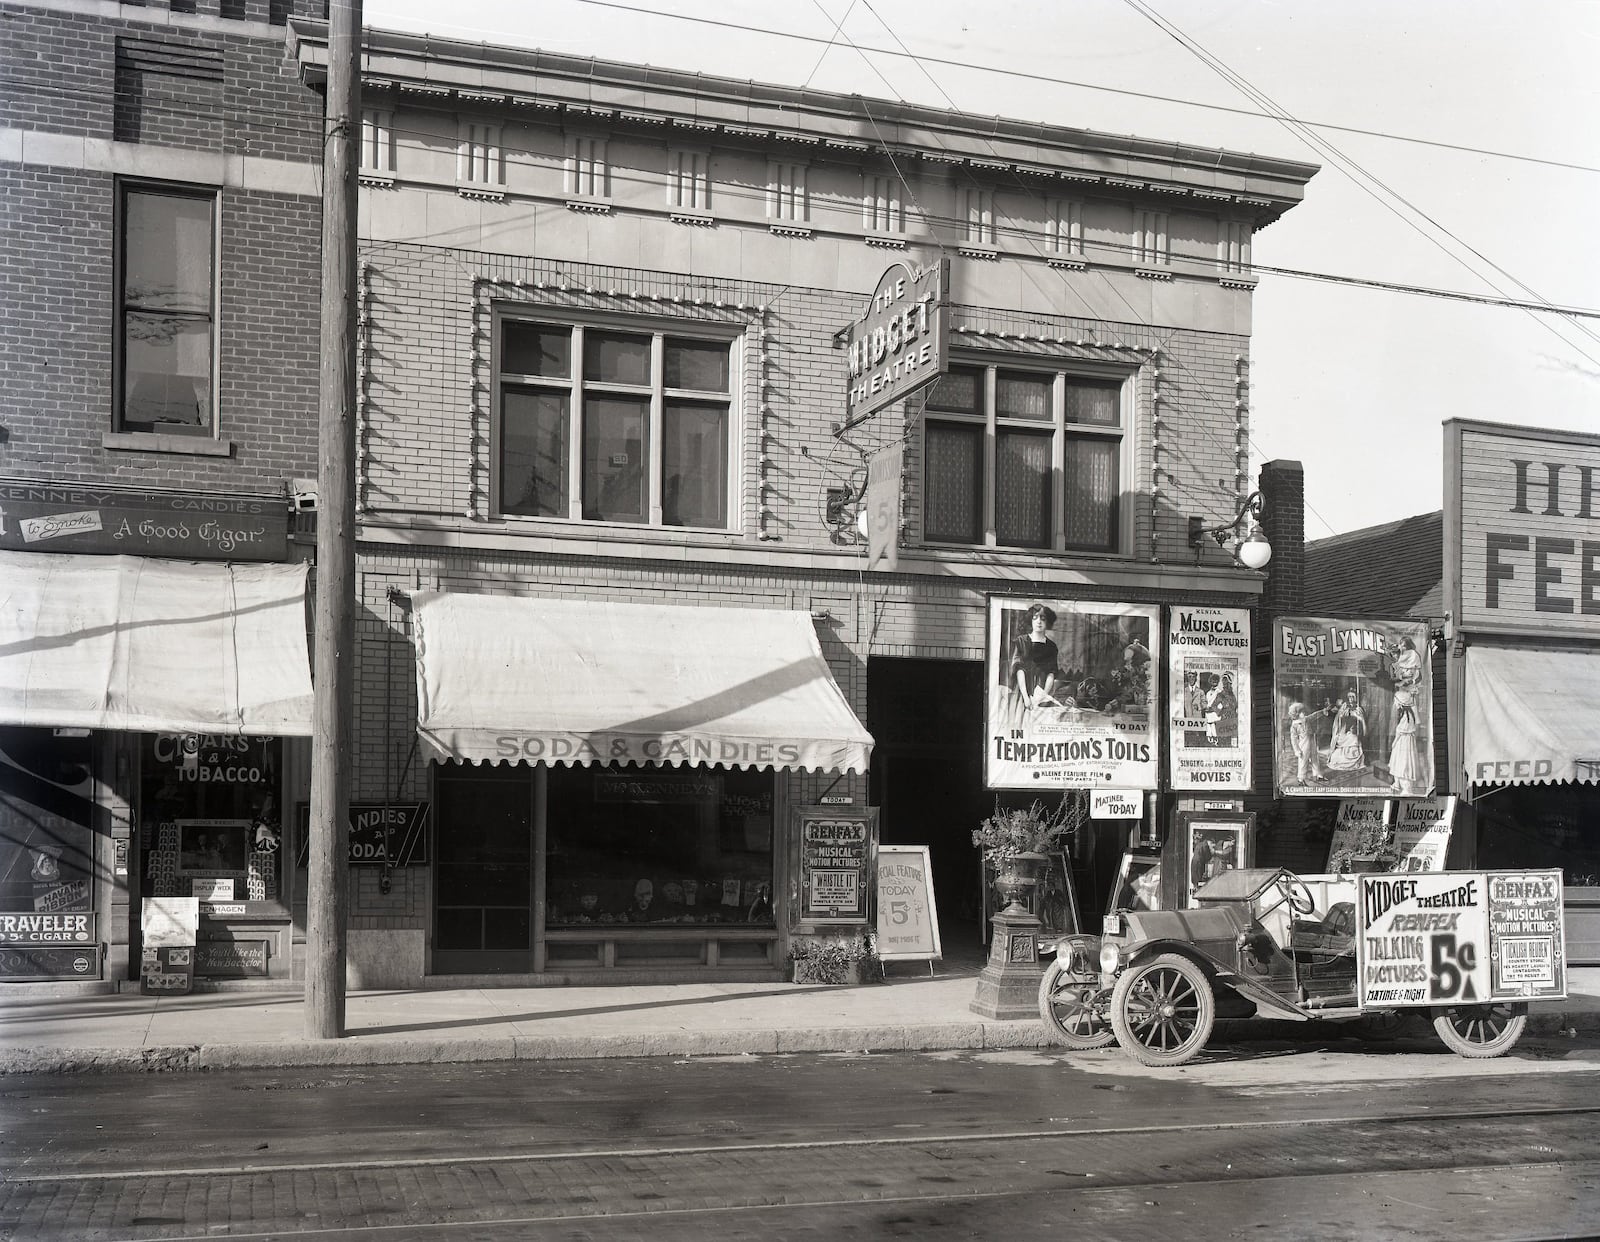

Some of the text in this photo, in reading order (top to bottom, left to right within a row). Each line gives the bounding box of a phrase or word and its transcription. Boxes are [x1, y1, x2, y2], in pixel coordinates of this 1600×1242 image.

[875, 277, 906, 314] THE
[849, 291, 935, 380] MIDGET
[849, 342, 932, 407] THEATRE
[171, 499, 263, 514] CANDIES
[113, 518, 266, 552] A Good Cigar.
[1179, 612, 1241, 633] MUSICAL
[1171, 632, 1248, 648] MOTION PICTURES
[1281, 624, 1386, 657] EAST LYNNE
[1115, 723, 1126, 731] TO
[1128, 723, 1147, 732] DAY
[1187, 720, 1205, 728] DAY
[1011, 729, 1024, 740] IN
[154, 733, 249, 763] CIARS
[495, 736, 799, 763] SODA & CANDIES
[994, 736, 1150, 763] TEMPTATION'S TOILS
[208, 752, 219, 764] &
[1180, 760, 1204, 768] SINGING
[1214, 760, 1242, 768] DANCING
[175, 765, 266, 782] TOBACCO.
[1190, 772, 1231, 782] MOVIES
[1476, 759, 1552, 779] FEED
[1095, 795, 1124, 809] MATINEE
[1108, 803, 1137, 815] TO-DAY
[1406, 803, 1445, 821] MUSICAL
[374, 828, 396, 839] AD
[810, 825, 862, 840] RENFAX
[1397, 821, 1419, 833] MOTION
[818, 847, 853, 857] MUSICAL
[809, 857, 861, 867] MOTION PICTURES
[897, 864, 922, 882] FEATURE
[44, 880, 84, 904] HAVANA
[880, 886, 917, 897] TODAY
[1495, 880, 1554, 899] RENFAX
[38, 890, 82, 912] RIBBON
[1364, 879, 1478, 930] MIDGET THEATRE
[1387, 912, 1462, 933] RENFEX
[1505, 908, 1545, 921] MUSICAL
[1496, 921, 1555, 933] MOTION PICTURES
[30, 932, 72, 941] CIGAR
[232, 947, 248, 957] like
[249, 947, 263, 957] the
[1366, 935, 1424, 961] TALKING
[1366, 963, 1428, 984] PICTURES
[1366, 988, 1399, 1002] MATINEE
[1403, 988, 1427, 1002] NIGHT
